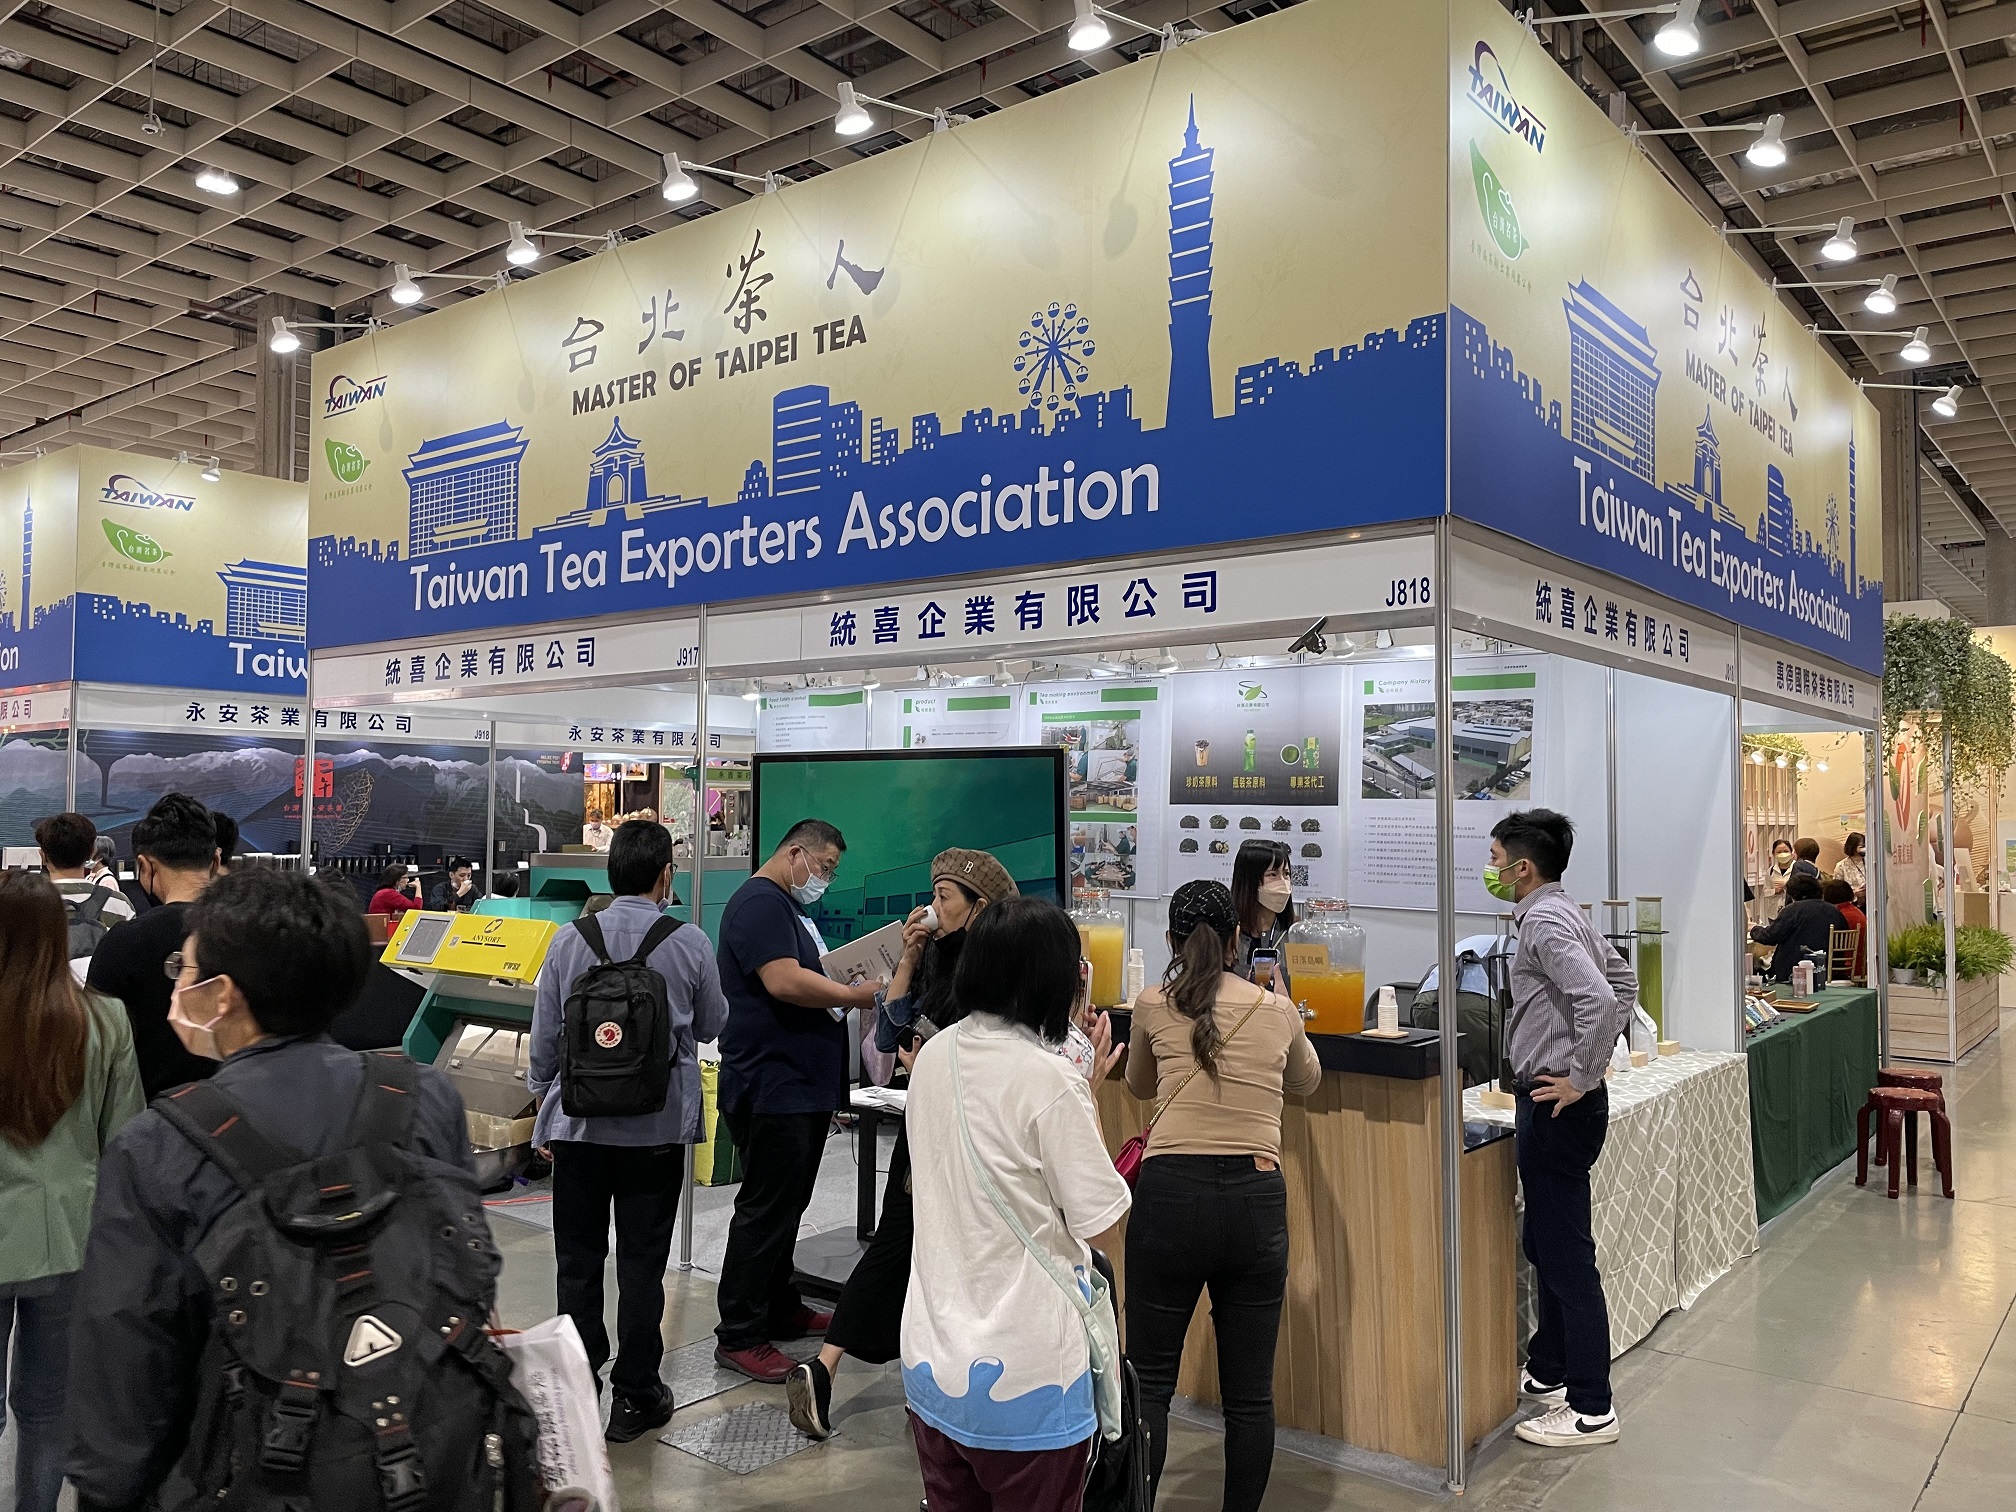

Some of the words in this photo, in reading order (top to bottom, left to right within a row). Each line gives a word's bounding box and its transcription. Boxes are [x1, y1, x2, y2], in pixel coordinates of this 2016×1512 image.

[1468, 64, 1545, 154] TAIWAN
[562, 229, 885, 373] 台北茶人
[1680, 267, 1798, 422] 台北茶人
[572, 370, 656, 415] MASTER
[669, 357, 701, 391] OF
[715, 332, 797, 379] TAIPEI
[813, 315, 867, 355] TEA
[325, 382, 387, 413] TAIWAN
[1685, 348, 1726, 405] MASTER
[1731, 386, 1745, 417] OF
[1749, 399, 1776, 443] TAIPEI
[1779, 424, 1794, 457] TEA
[101, 487, 194, 511] TAIWAN
[409, 561, 528, 612] Taiwan
[539, 541, 606, 595] Tea
[620, 514, 822, 589] Exporters
[837, 463, 1159, 556] Association
[1573, 455, 1663, 561] Taiwan
[1668, 506, 1706, 579] Tea
[1710, 528, 1785, 613] Exporters
[1788, 569, 1851, 642] Association
[829, 570, 1218, 648] 統喜企業有限公司
[1386, 577, 1431, 607] J818
[1535, 579, 1690, 663] 統喜企業有限公司
[385, 636, 596, 687] 統喜企業有限公司
[677, 646, 699, 667] J917
[1776, 661, 1854, 708] 惠德國際茶業有限公司
[186, 702, 412, 733] 永安茶業有限公司
[475, 730, 490, 740] J918
[1185, 776, 1218, 788] 珍奶茶原料
[1232, 776, 1266, 789] 瓶裝茶原料
[1289, 775, 1325, 789] 專業茶代工
[963, 861, 974, 873] B
[472, 934, 502, 943] ANYSORT
